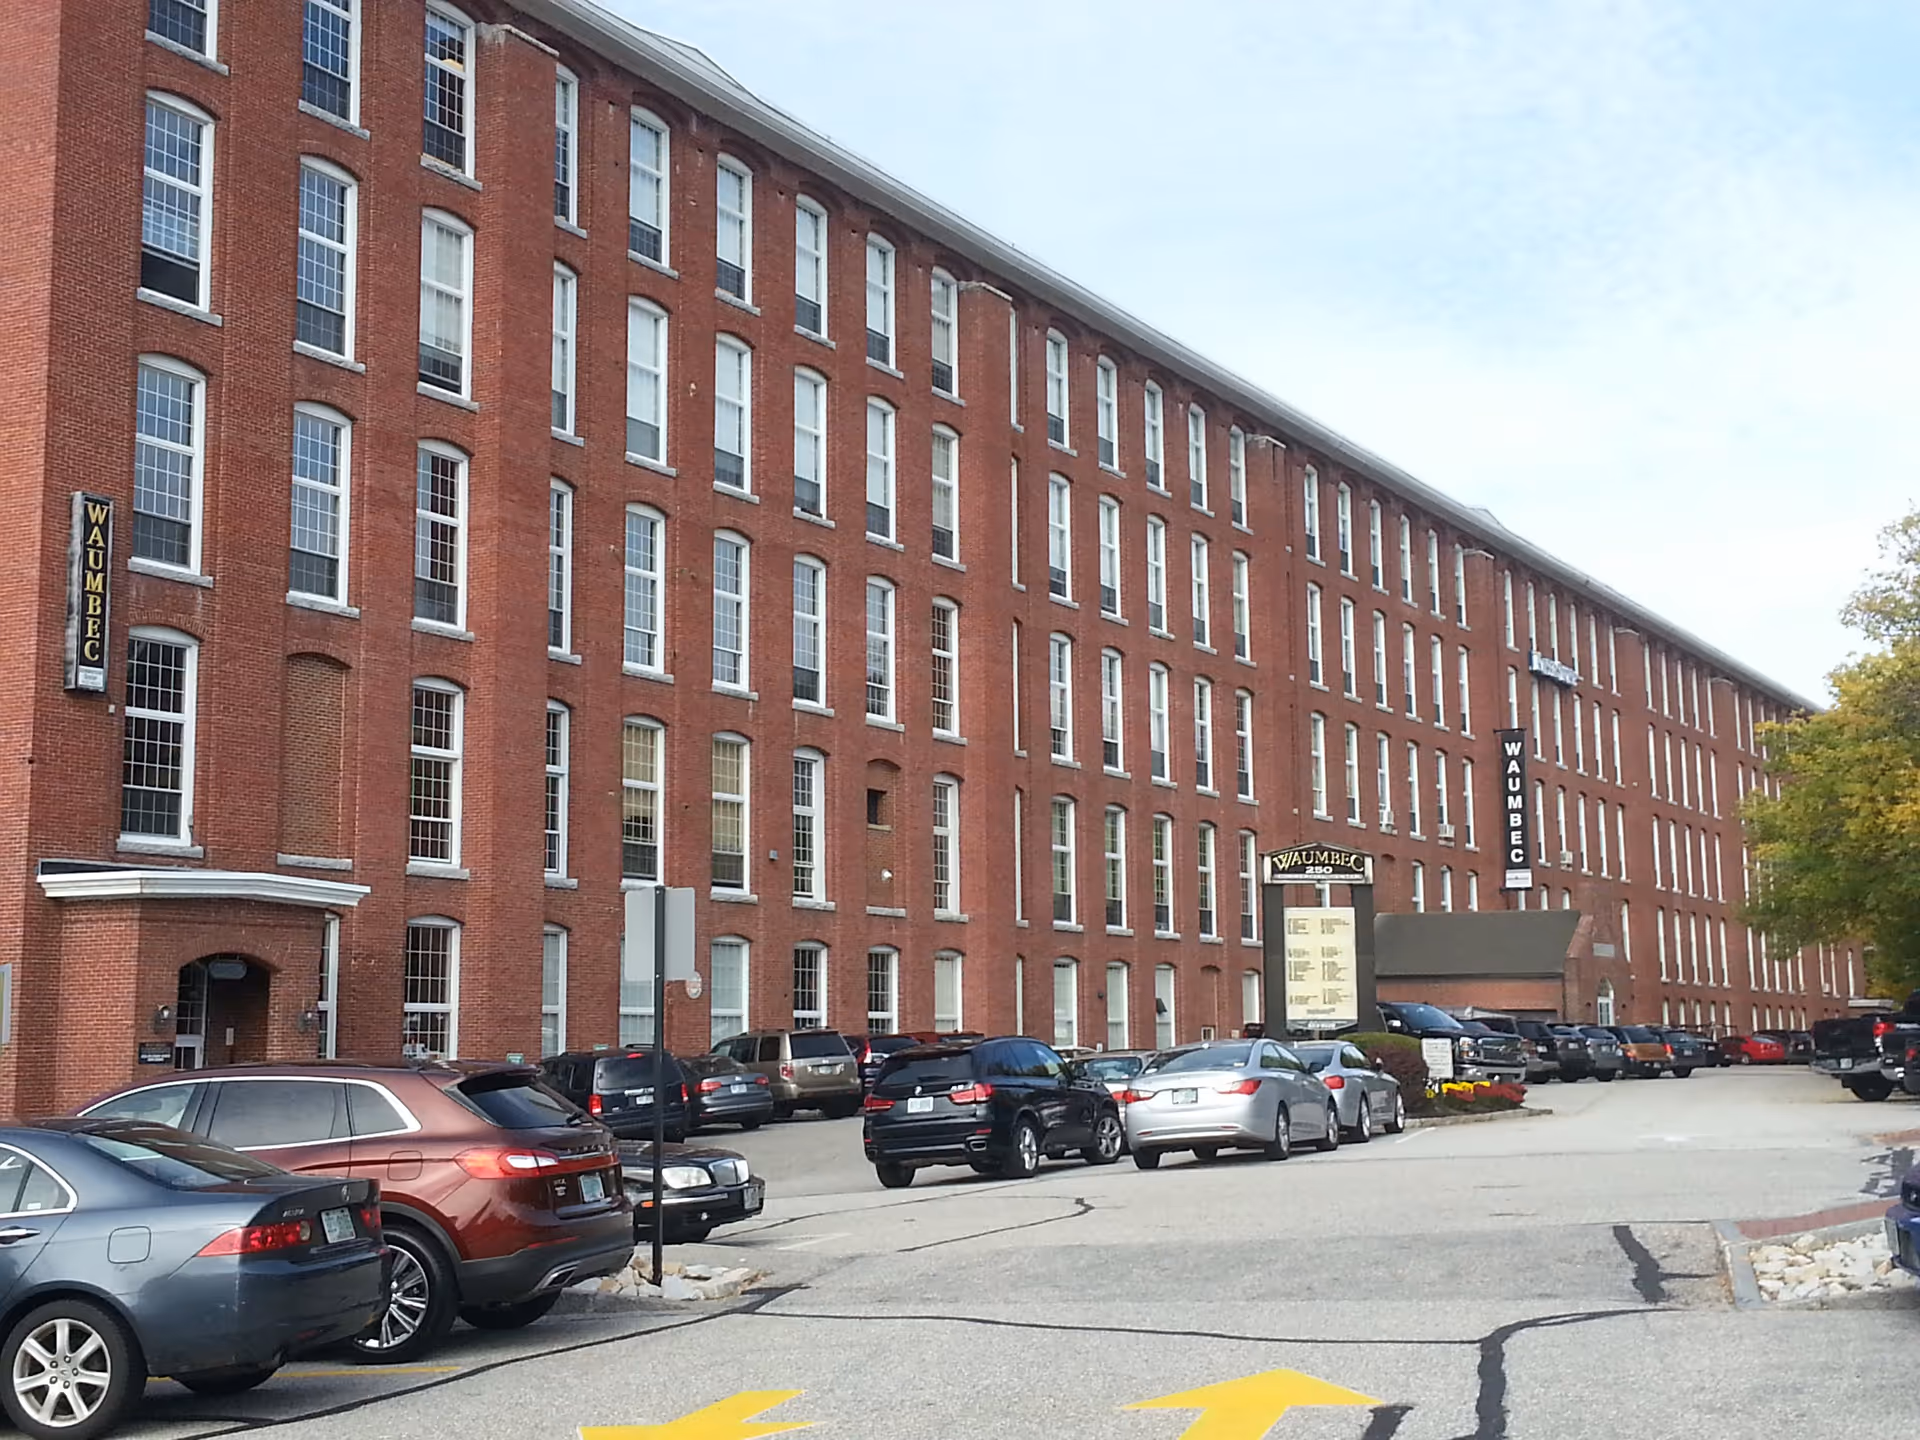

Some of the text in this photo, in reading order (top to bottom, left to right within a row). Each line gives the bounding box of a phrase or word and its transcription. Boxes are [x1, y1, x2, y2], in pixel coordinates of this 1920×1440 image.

[84, 502, 109, 661] WAUMBEC
[1504, 742, 1524, 863] WAUMBEC
[1273, 851, 1364, 872] WAUMBEC
[1305, 866, 1333, 874] 250
